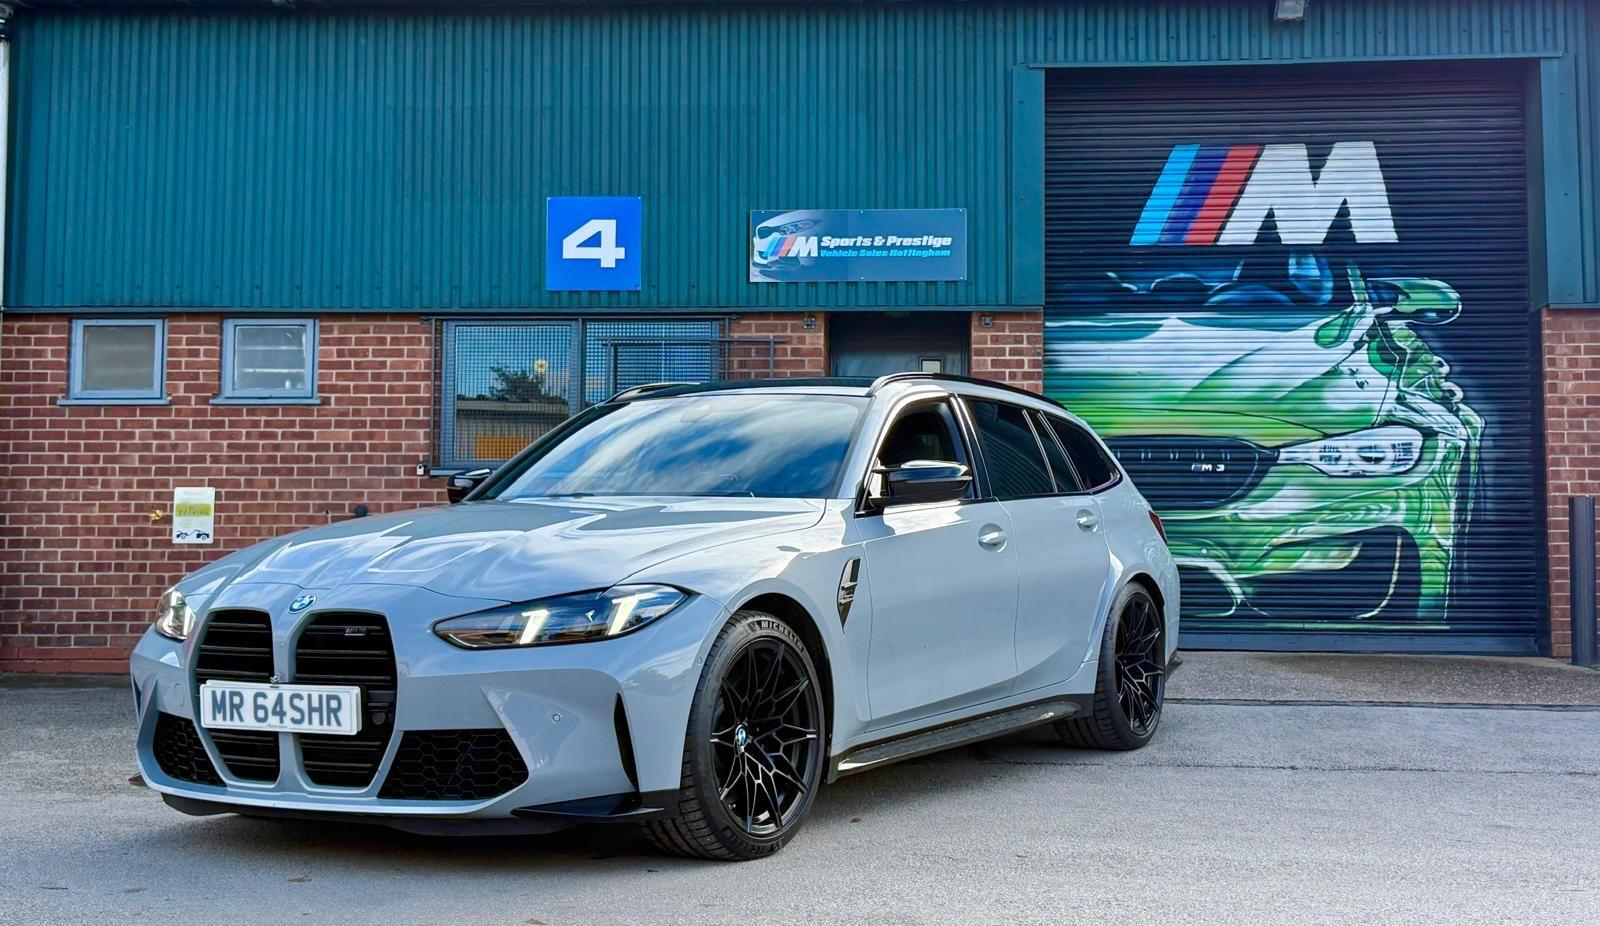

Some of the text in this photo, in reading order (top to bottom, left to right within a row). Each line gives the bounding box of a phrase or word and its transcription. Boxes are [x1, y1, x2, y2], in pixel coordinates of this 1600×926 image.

[562, 219, 625, 268] 4
[820, 235, 952, 248] Sports & Prestige
[820, 248, 951, 258] Vehicle Sales Nottingham
[211, 689, 342, 728] MR 64SHR
